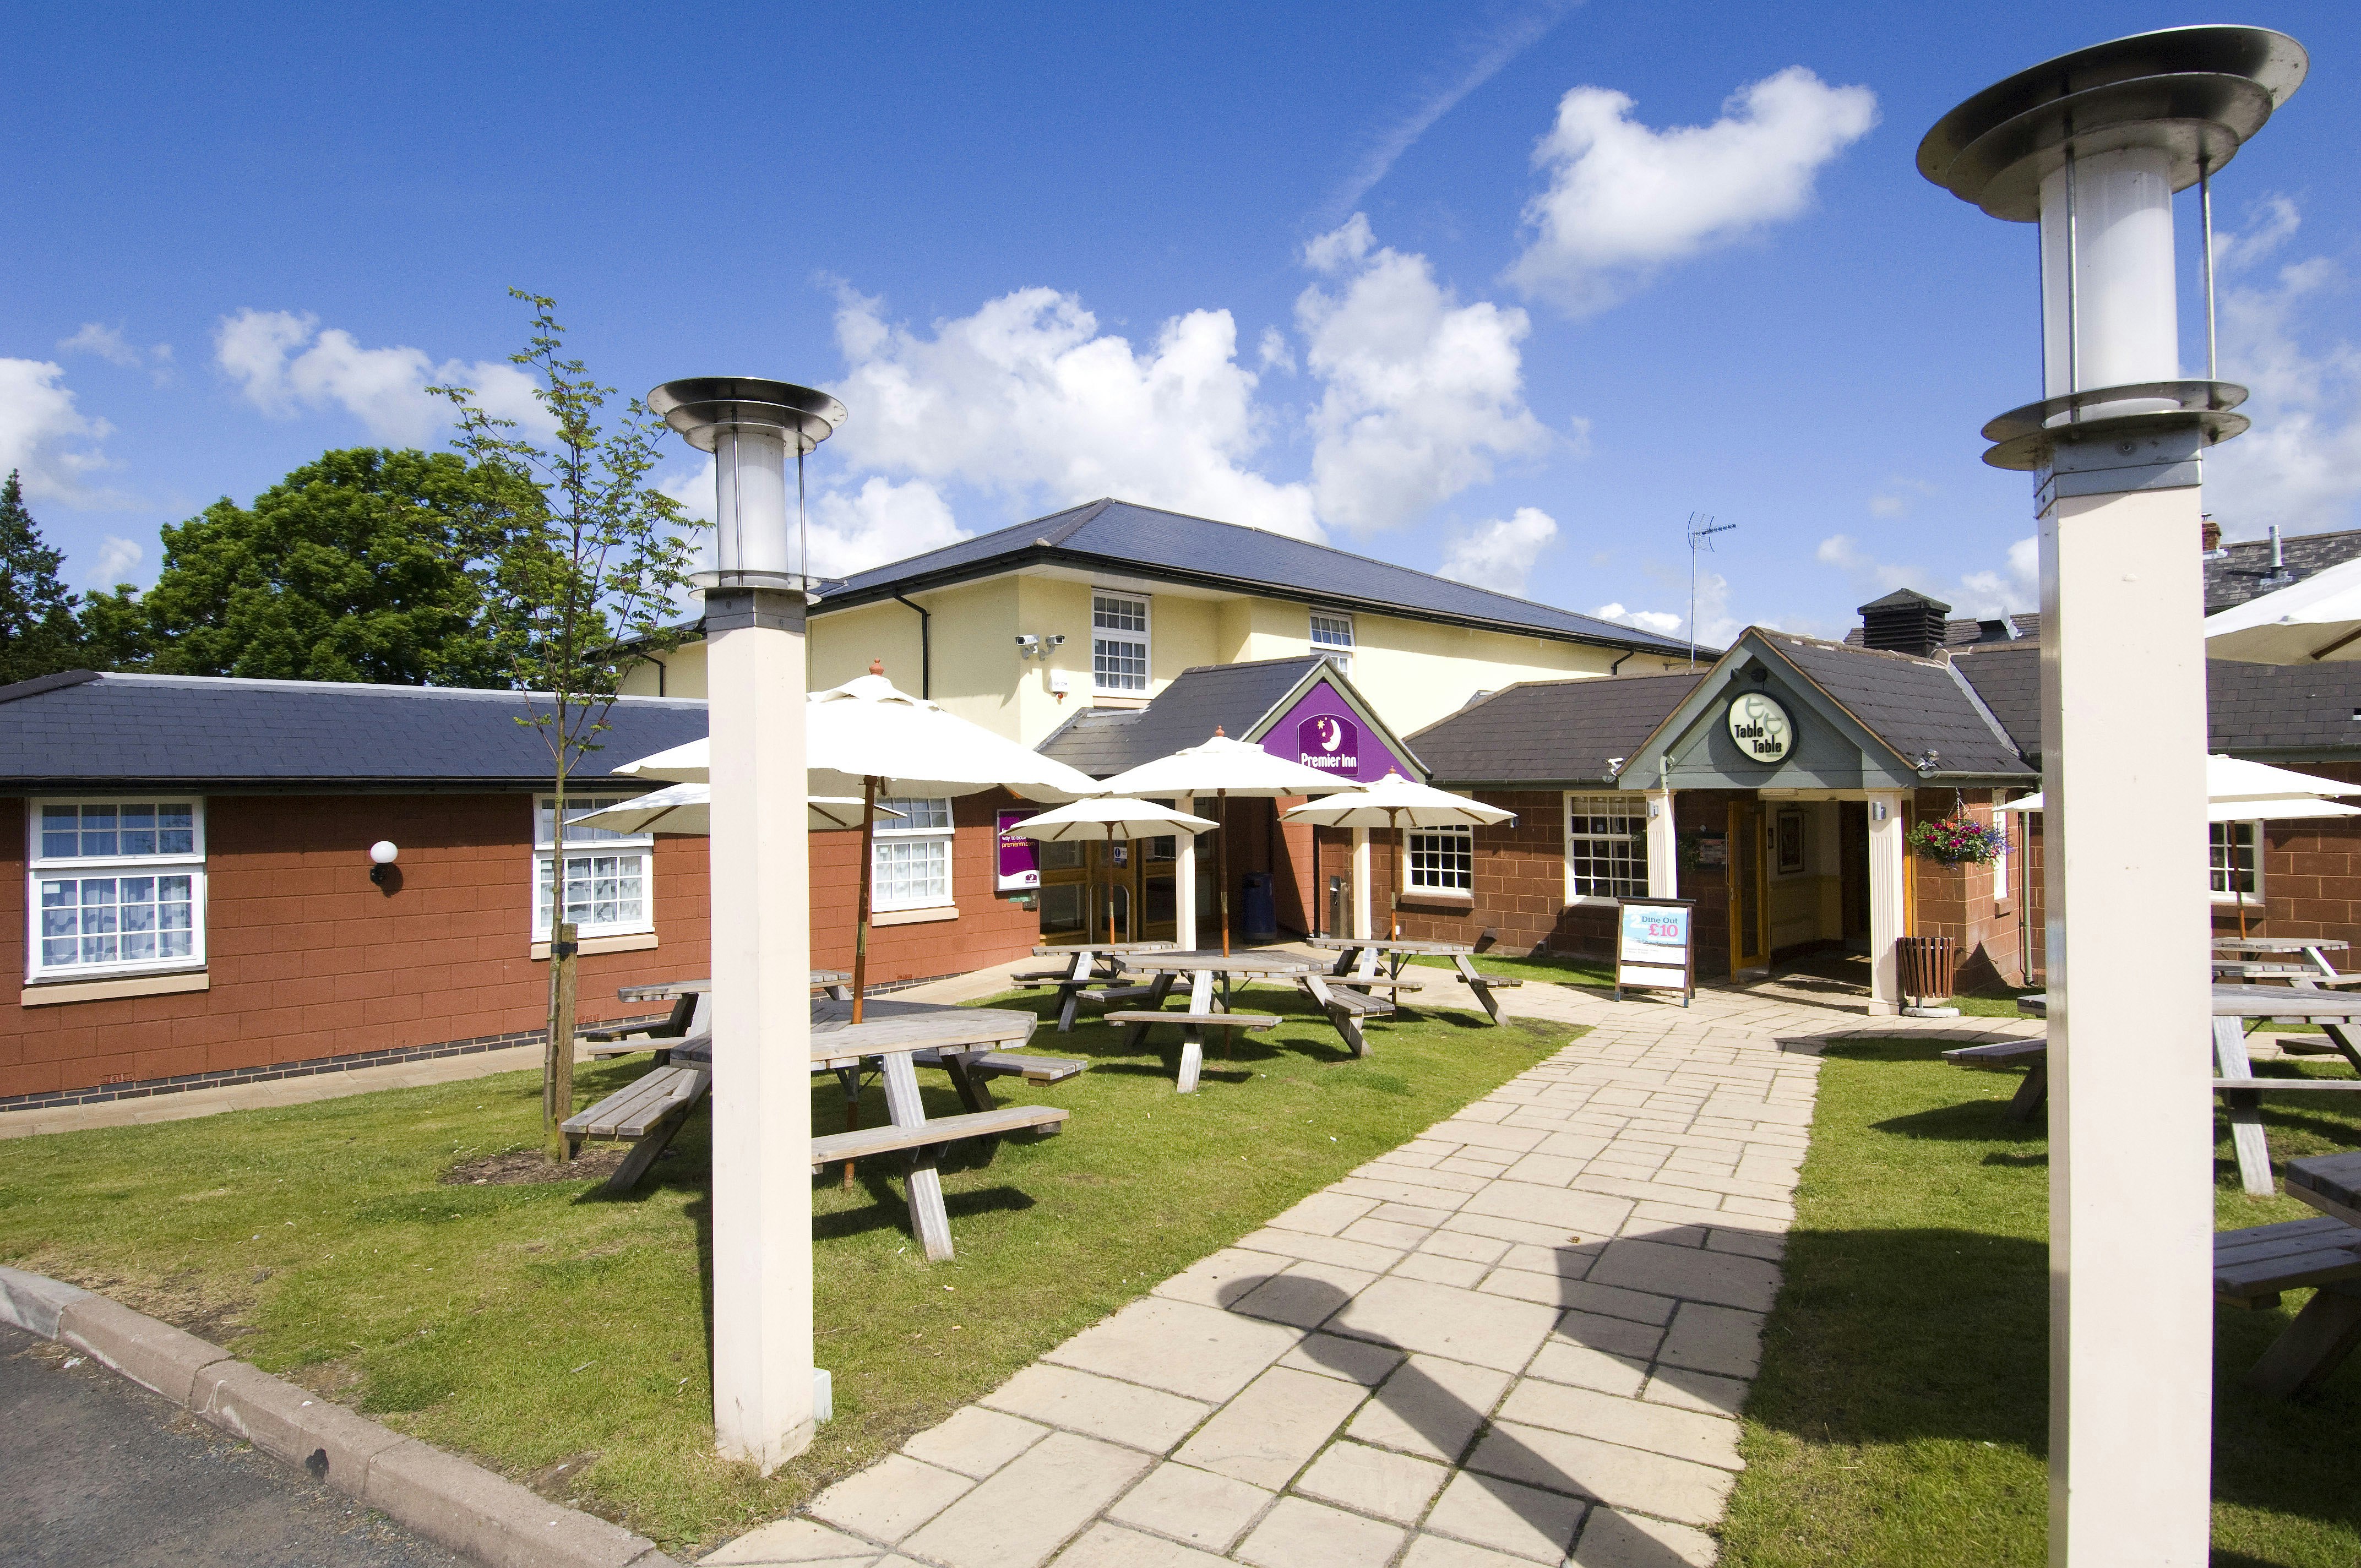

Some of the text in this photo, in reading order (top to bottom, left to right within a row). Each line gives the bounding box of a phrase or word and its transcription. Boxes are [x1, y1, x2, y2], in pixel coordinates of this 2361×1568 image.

[1734, 720, 1763, 738] Table
[1752, 734, 1782, 753] Table
[1301, 753, 1357, 767] Premier Inn
[1649, 923, 1678, 938] £10
